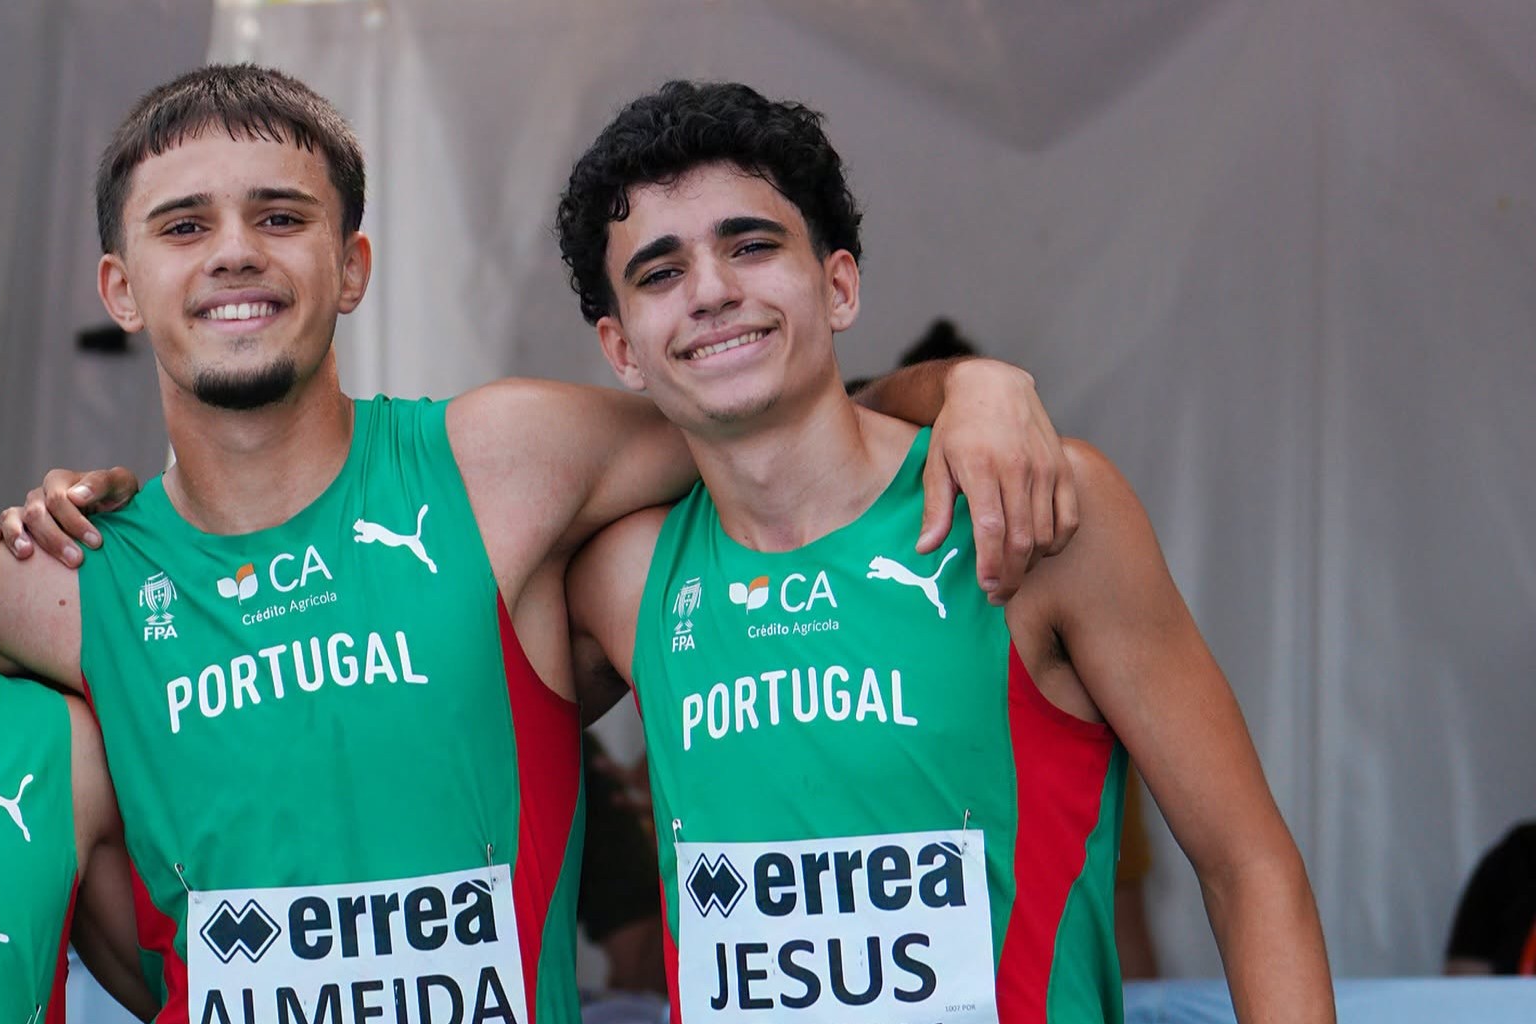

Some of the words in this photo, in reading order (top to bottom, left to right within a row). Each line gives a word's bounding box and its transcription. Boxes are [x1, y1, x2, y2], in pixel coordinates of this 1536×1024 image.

[269, 544, 333, 593] CA
[242, 603, 286, 626] Crédito
[289, 590, 337, 612] Agrícola
[780, 570, 838, 613] CA
[144, 624, 178, 641] FPA
[672, 634, 695, 653] FPA
[748, 623, 790, 638] Crédito
[792, 619, 840, 636] Agrícola
[166, 630, 428, 734] PORTUGAL
[682, 665, 918, 752] PORTUGAL
[710, 933, 937, 1010] JESUS
